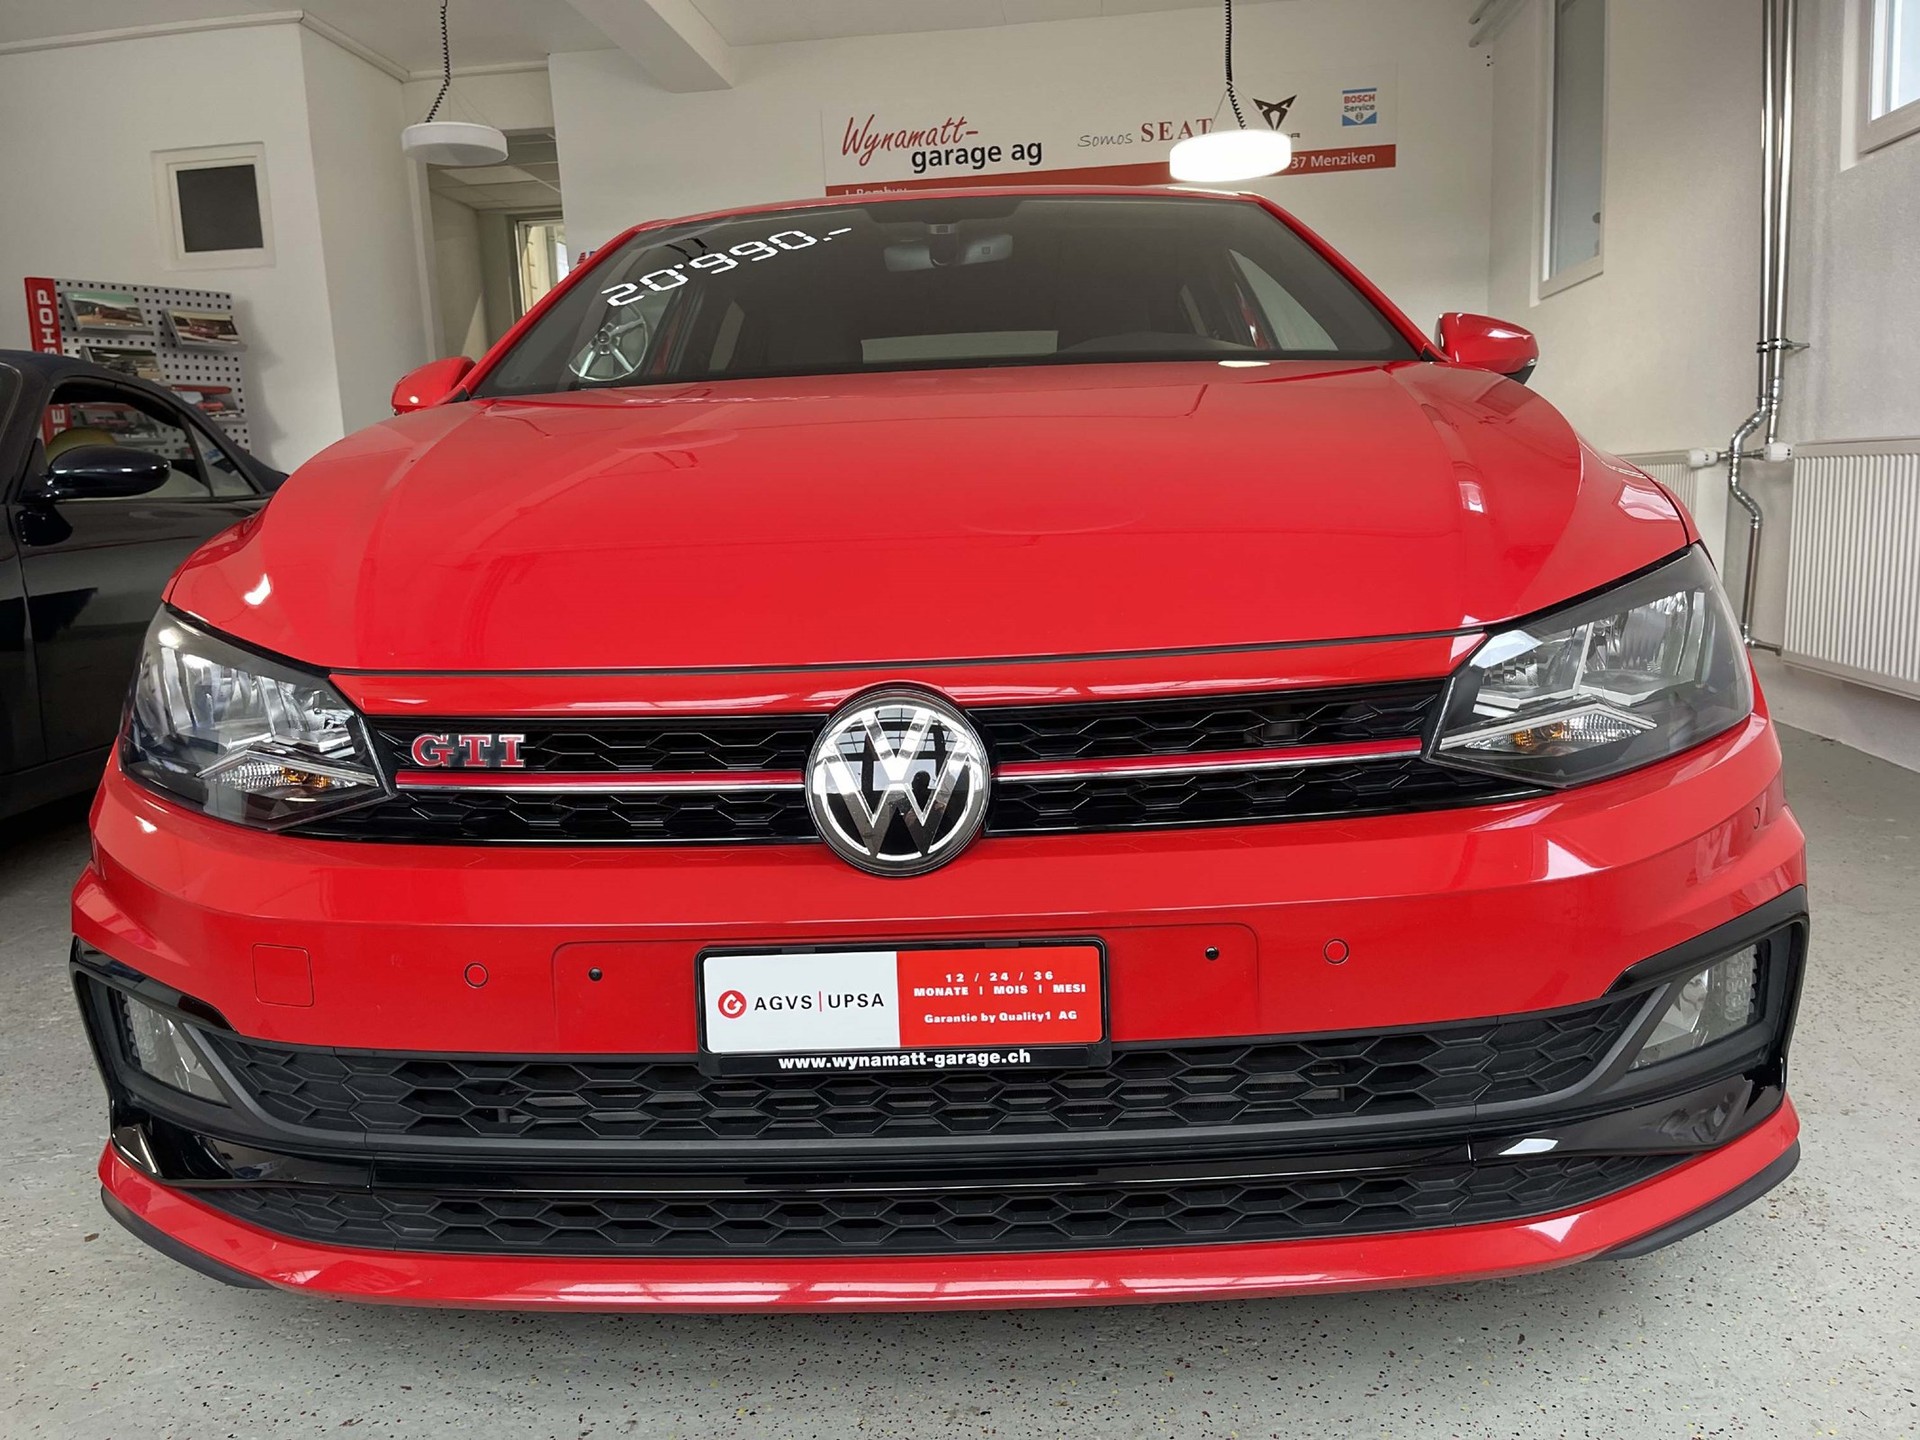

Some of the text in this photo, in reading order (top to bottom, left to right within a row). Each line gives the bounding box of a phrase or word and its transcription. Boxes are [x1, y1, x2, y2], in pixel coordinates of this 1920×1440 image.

[1344, 94, 1375, 104] BOSCH
[1344, 104, 1375, 113] Service
[842, 114, 979, 167] Wynamatt-
[1077, 118, 1213, 148] Somos SEAT
[911, 141, 1043, 174] garage ag
[1291, 152, 1376, 169] 37 Menziken
[411, 733, 526, 768] GTI
[913, 986, 969, 997] MONATE
[993, 984, 1028, 995] MOIS
[1053, 983, 1086, 993] MESI
[754, 993, 884, 1011] AGVS UPSA
[924, 1010, 1077, 1023] Garantie by Quality1 AG
[778, 1049, 1031, 1070] www.wynamatt-garage.ch
